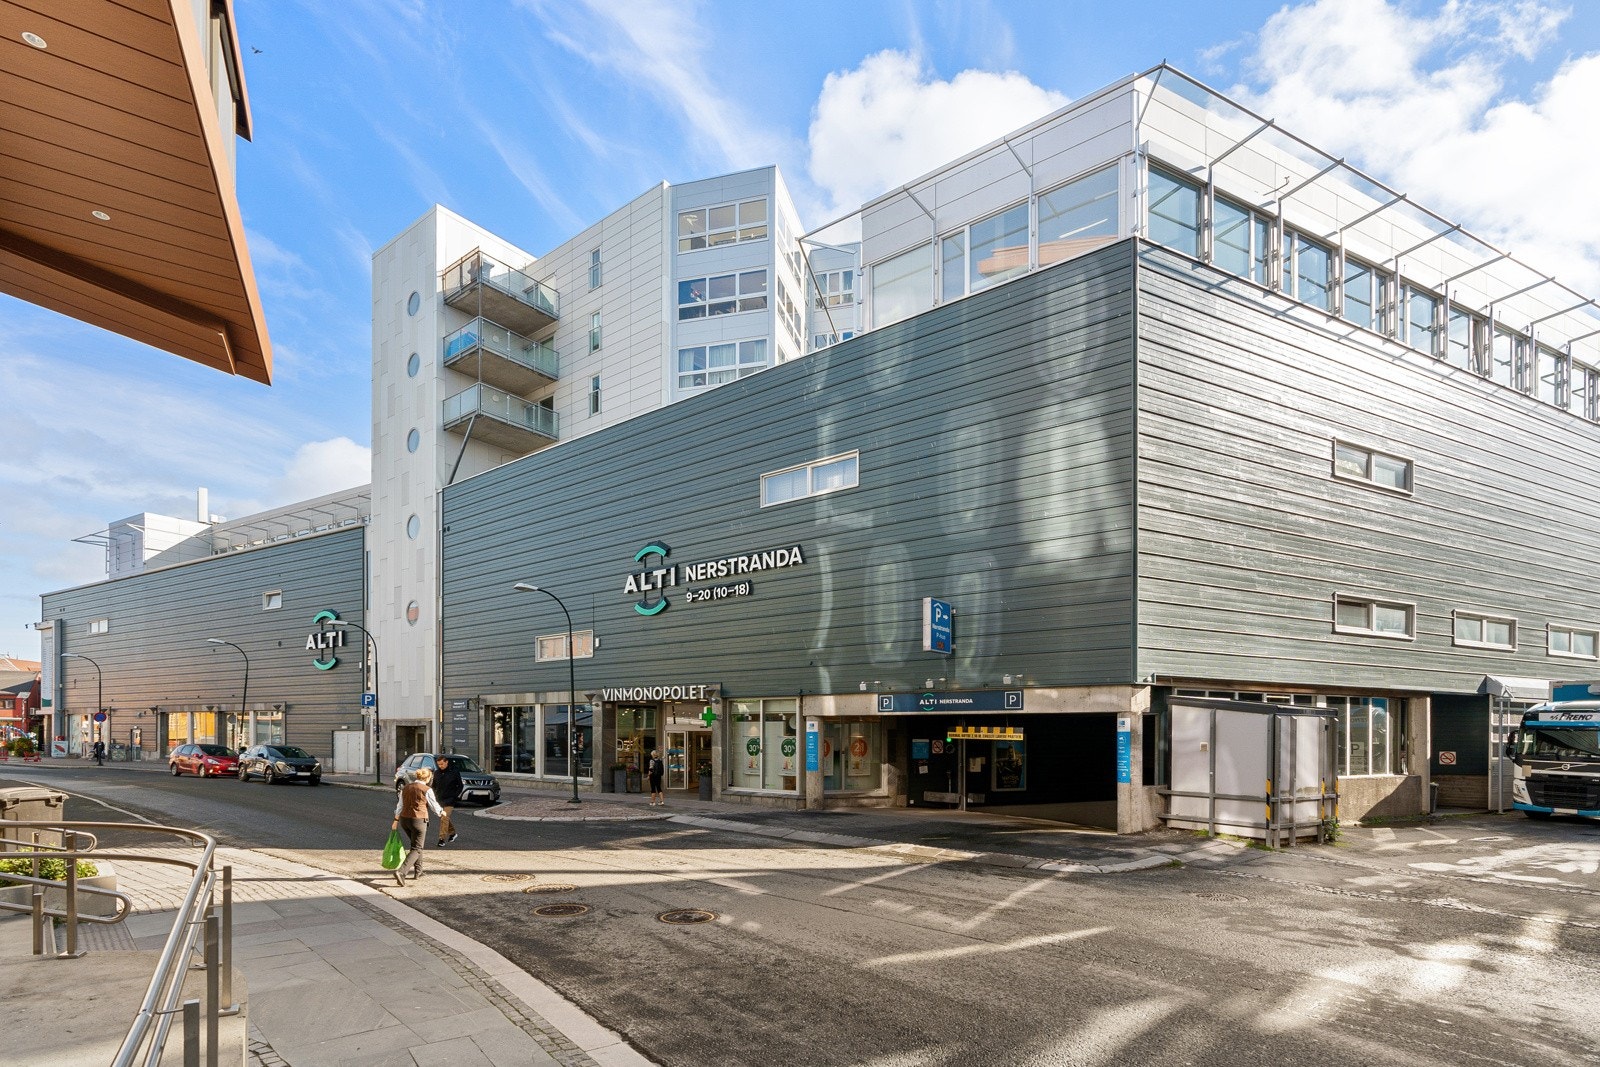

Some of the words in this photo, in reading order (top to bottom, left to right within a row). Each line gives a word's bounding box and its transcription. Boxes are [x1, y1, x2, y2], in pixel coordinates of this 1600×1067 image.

[624, 567, 676, 594] ALTI
[685, 546, 803, 582] NERSTRANDA
[936, 608, 942, 622] P
[305, 630, 343, 650] ALTI
[364, 695, 373, 705] P
[602, 685, 707, 701] VINMONOPOLET
[1009, 695, 1016, 705] P
[883, 698, 889, 707] P
